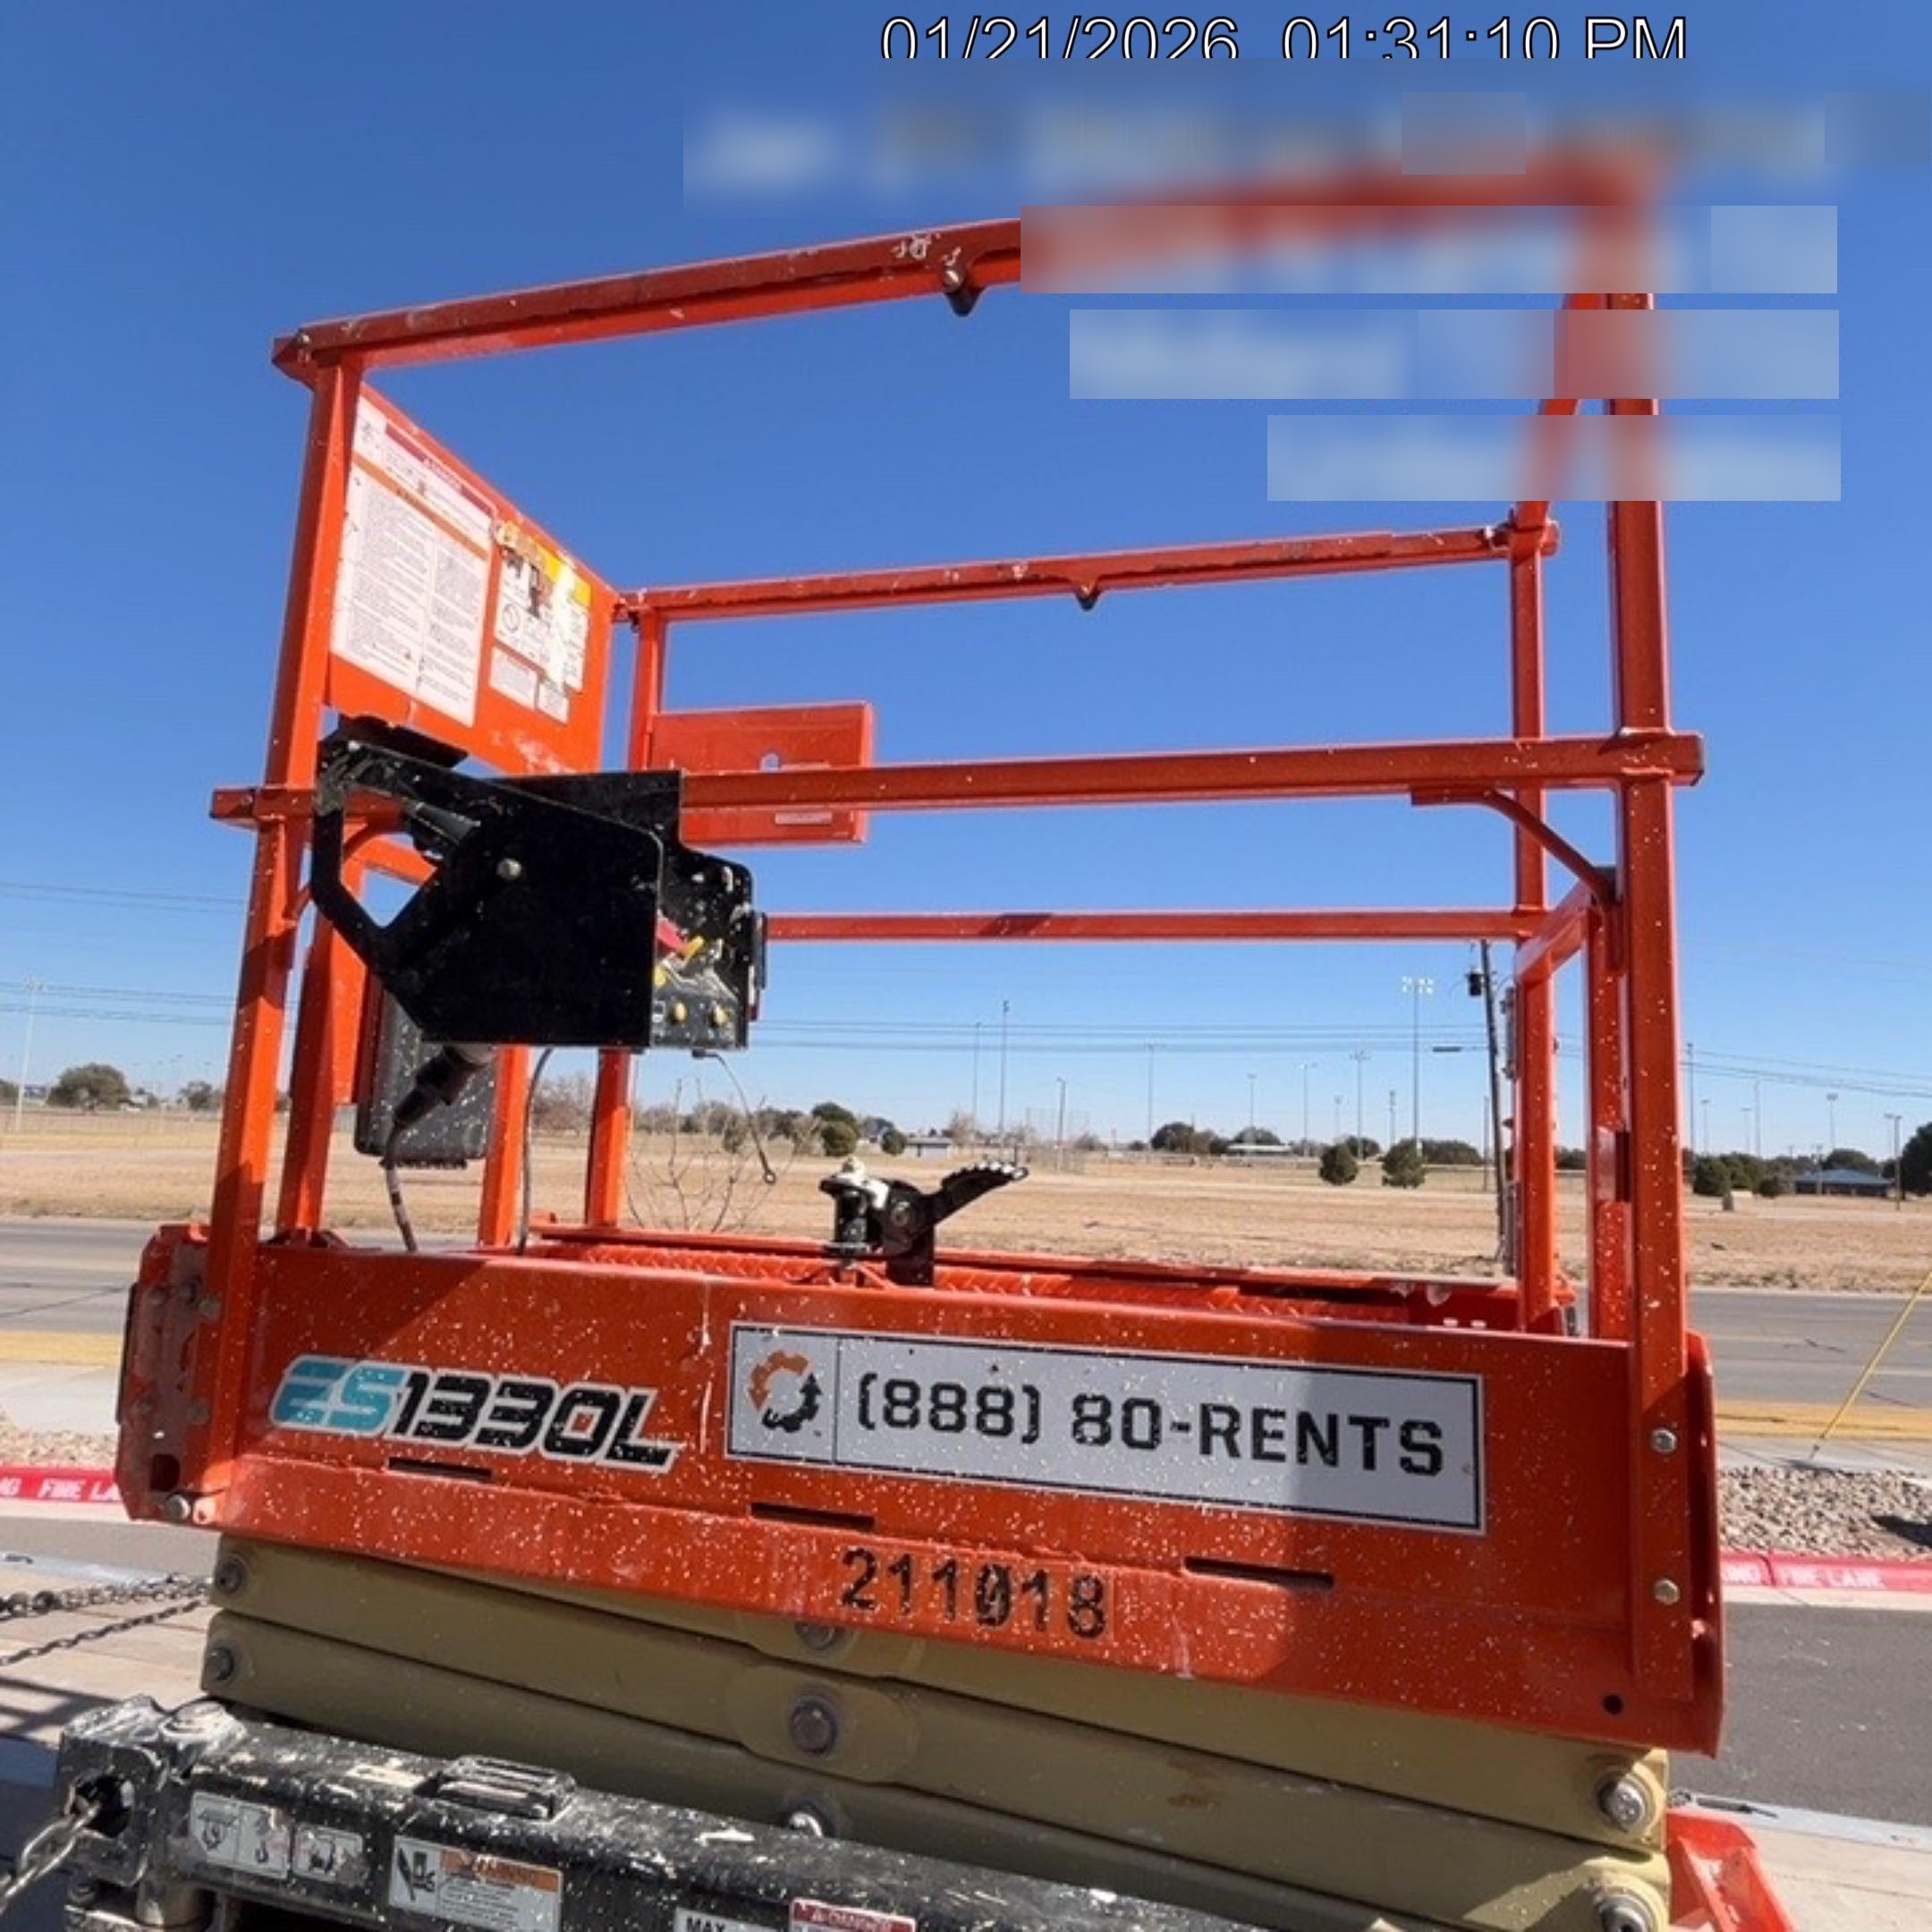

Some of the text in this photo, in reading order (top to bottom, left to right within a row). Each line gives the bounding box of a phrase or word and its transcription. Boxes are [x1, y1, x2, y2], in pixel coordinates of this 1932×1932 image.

[271, 1354, 687, 1474] ES1330L
[858, 1372, 1444, 1478] (888) 80-RENTS
[841, 1546, 1106, 1639] 211018
